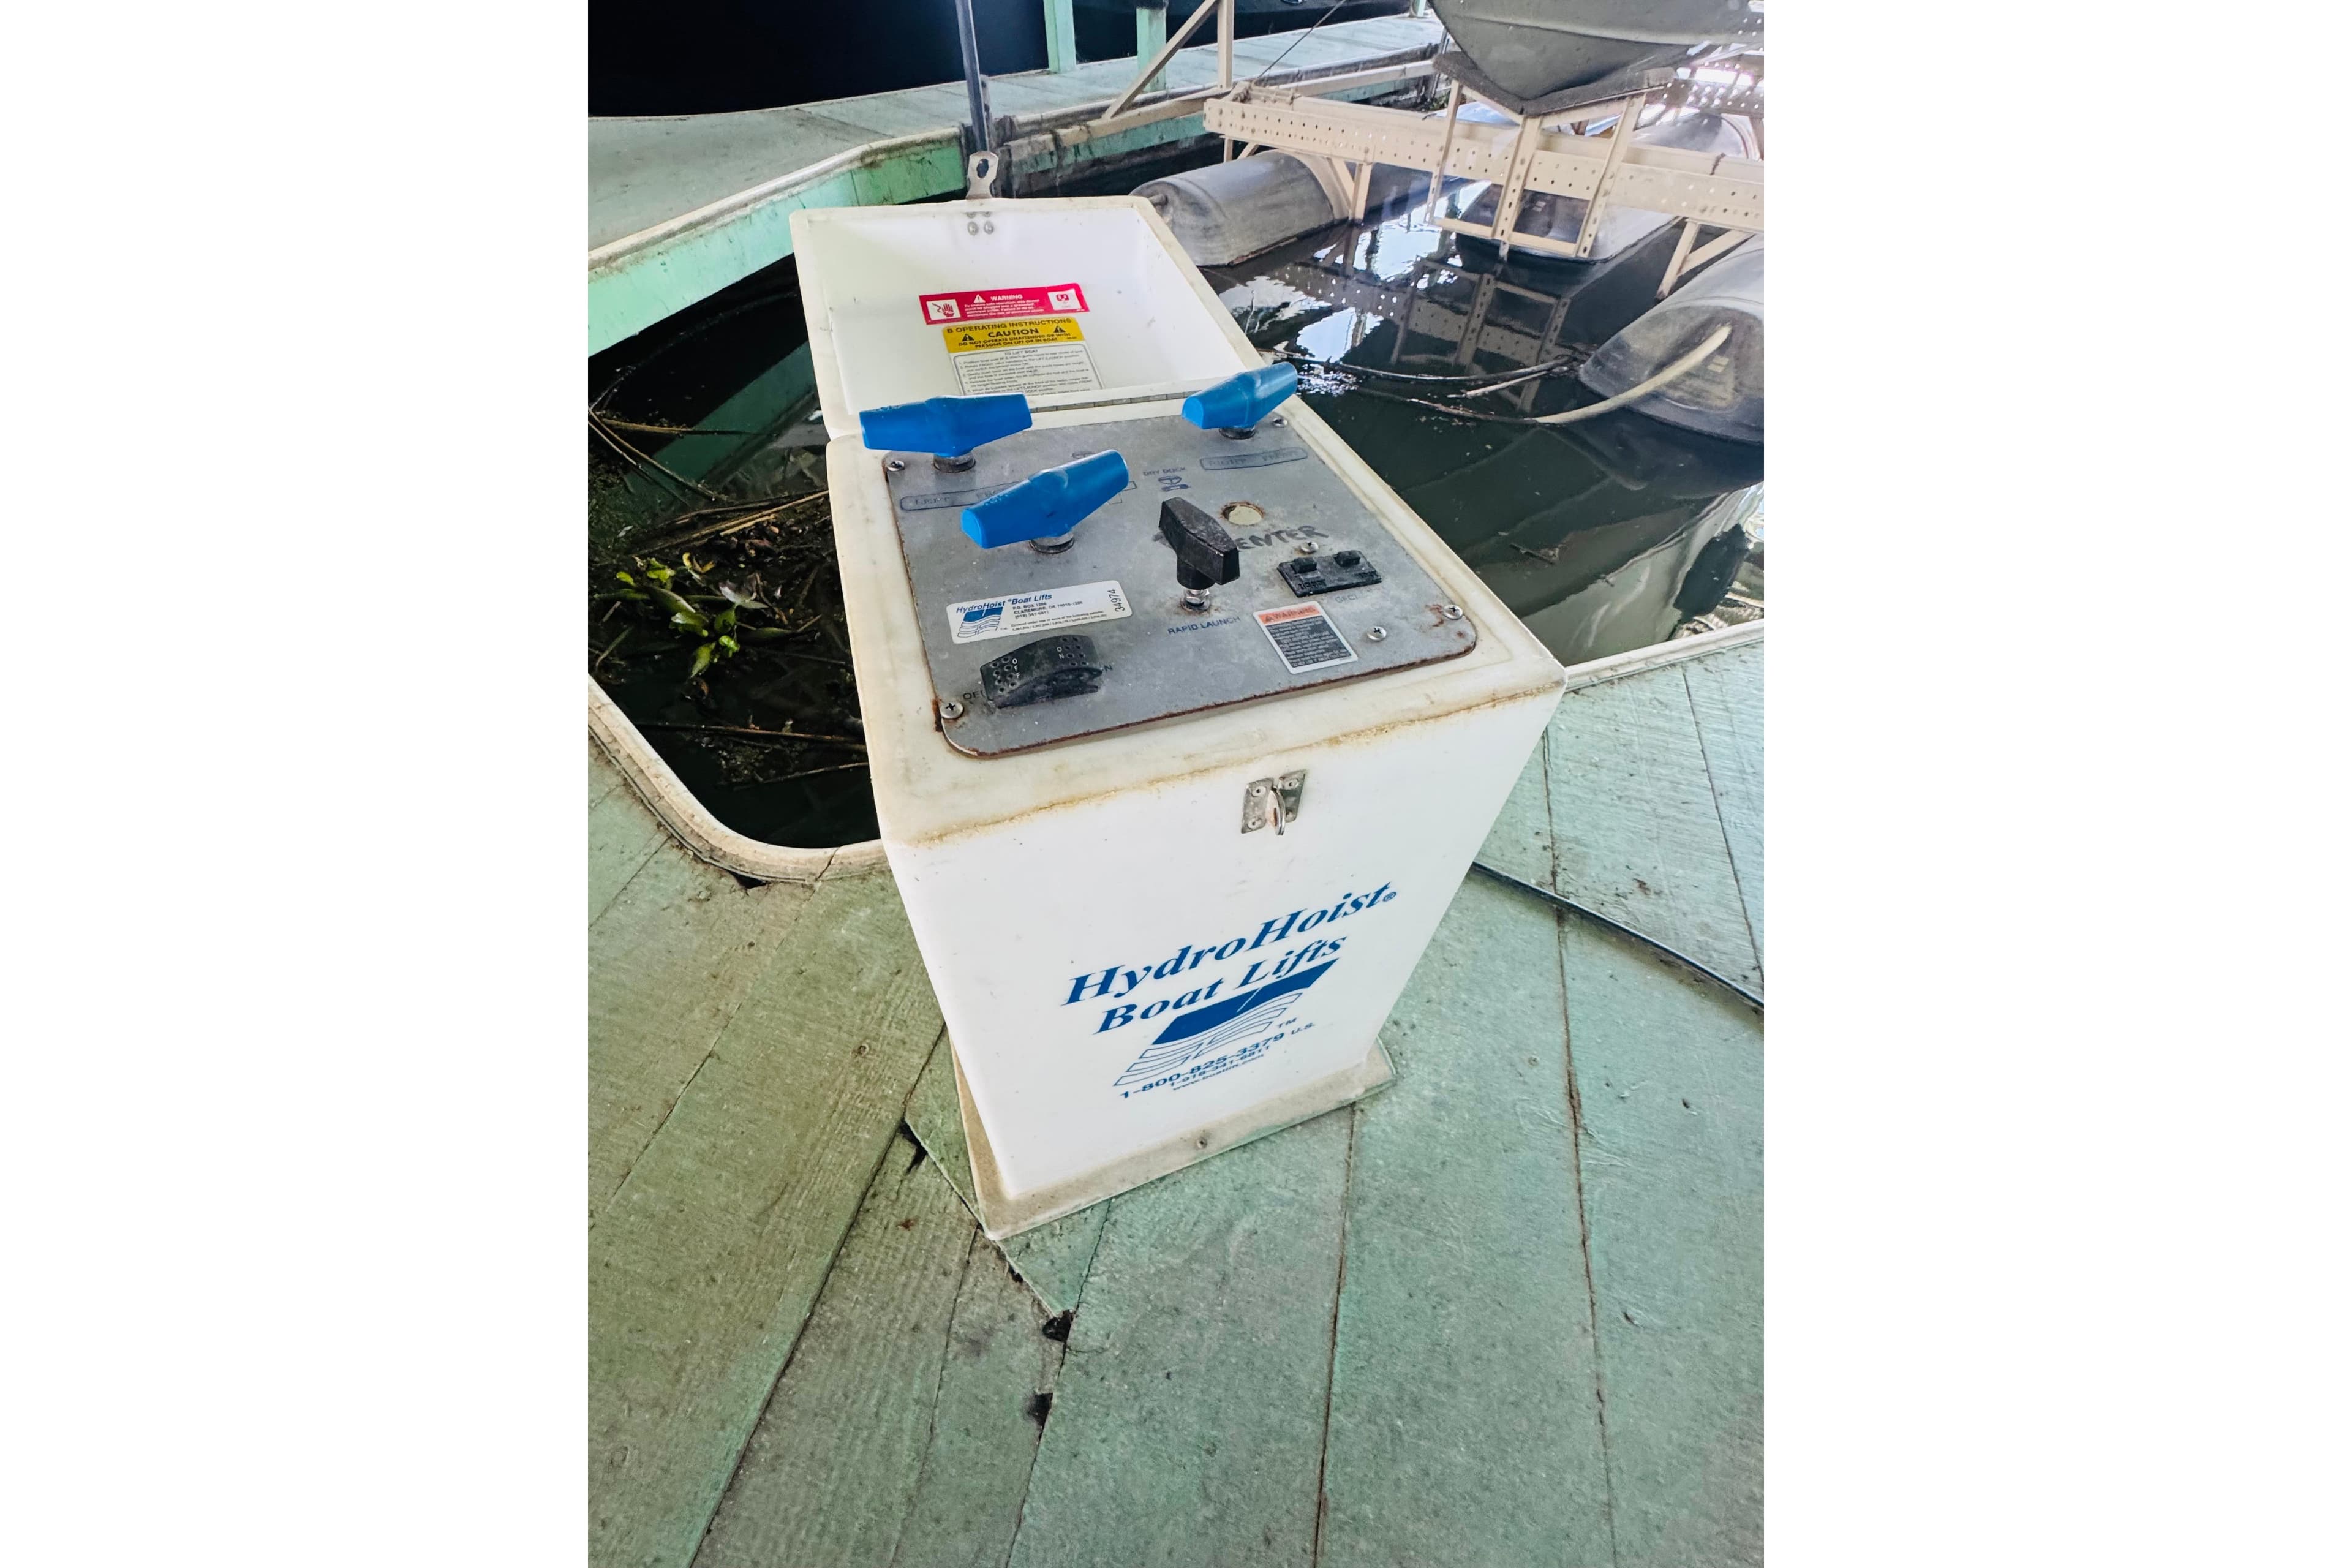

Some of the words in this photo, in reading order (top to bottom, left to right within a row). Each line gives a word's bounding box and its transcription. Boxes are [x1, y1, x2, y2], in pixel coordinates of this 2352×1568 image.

[956, 323, 1007, 333] OPERATING
[1009, 318, 1072, 328] INSTRUCTIONS
[987, 328, 1039, 338] CAUTION
[1033, 593, 1053, 601] Lifts
[1107, 589, 1126, 612] 34974
[1167, 624, 1199, 635] RAPID
[1200, 616, 1241, 629] LAUNCH
[1093, 977, 1224, 1035] Boat
[1234, 936, 1347, 989] Lifts
[1119, 1032, 1285, 1099] 1-800-825-3379
[1291, 1022, 1316, 1036] U.S.
